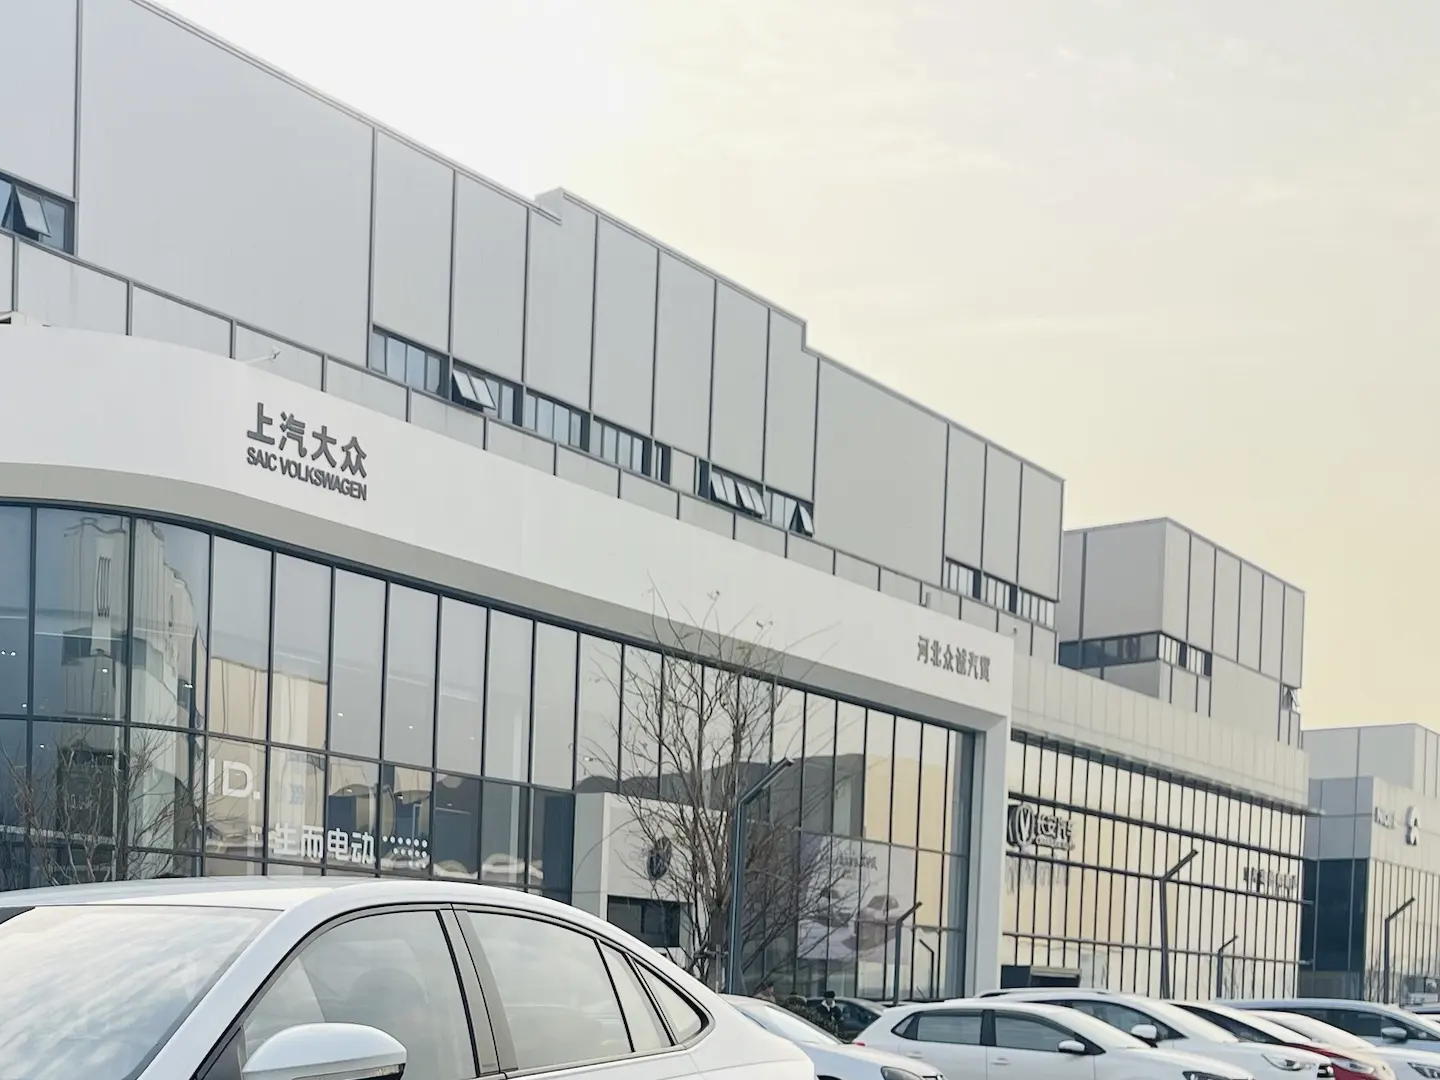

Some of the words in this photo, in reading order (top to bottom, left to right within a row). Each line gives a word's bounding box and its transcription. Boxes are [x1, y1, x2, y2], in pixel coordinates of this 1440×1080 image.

[247, 402, 367, 478] 上汽大众
[247, 447, 278, 472] SAIC
[279, 456, 367, 501] VOLKSWAGEN
[272, 822, 376, 865] 生而电动
